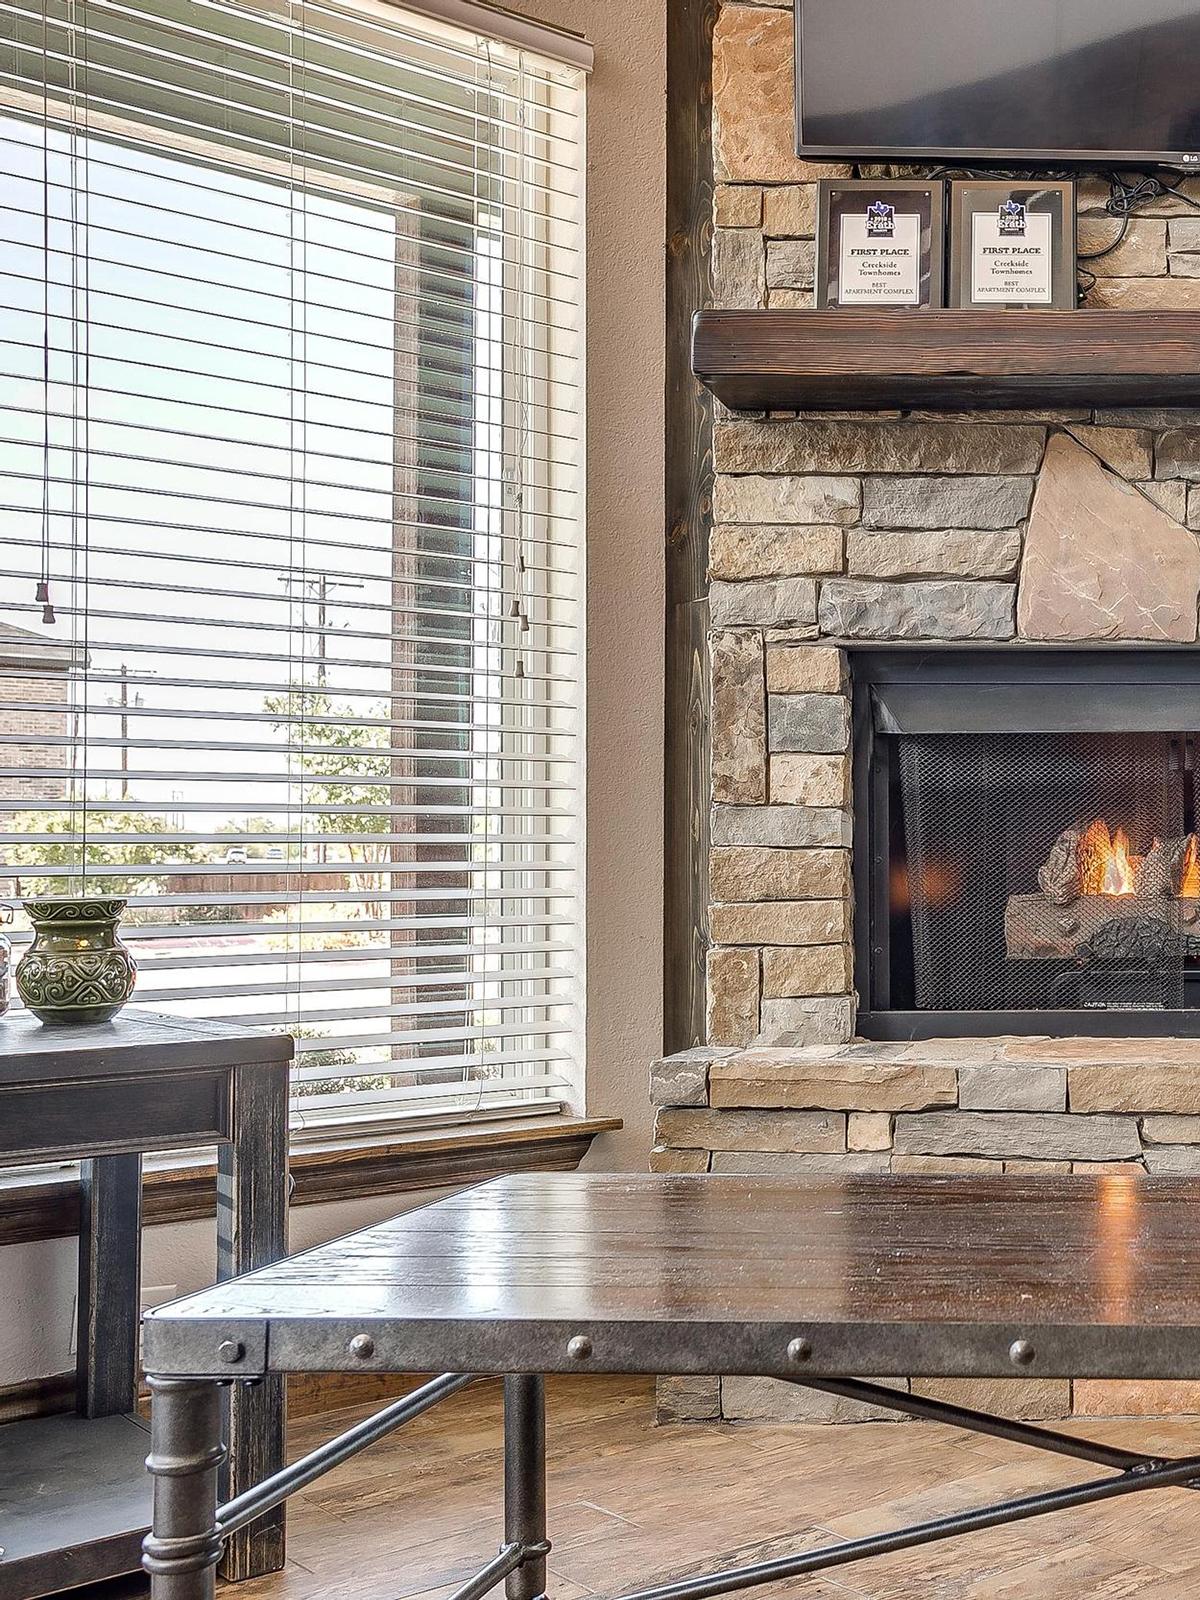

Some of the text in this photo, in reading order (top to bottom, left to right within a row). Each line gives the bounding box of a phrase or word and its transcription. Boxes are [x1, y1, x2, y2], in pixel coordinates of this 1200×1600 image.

[866, 220, 896, 230] Erath
[998, 219, 1027, 229] Erath
[850, 248, 910, 256] FIRST PLACE
[990, 267, 1033, 275] Townhomes
